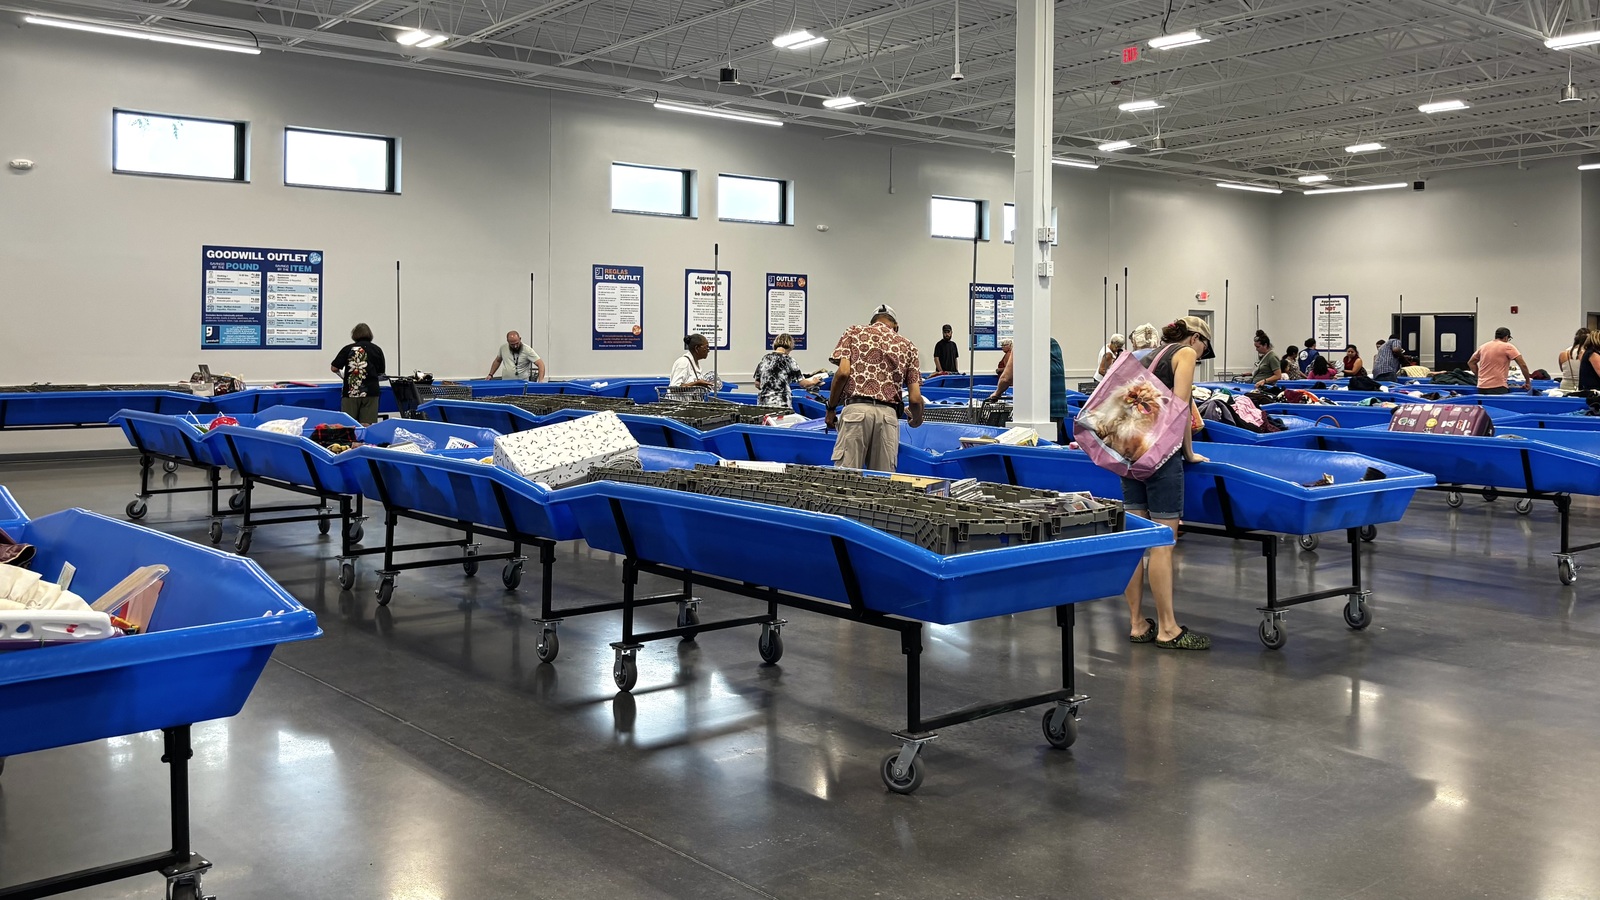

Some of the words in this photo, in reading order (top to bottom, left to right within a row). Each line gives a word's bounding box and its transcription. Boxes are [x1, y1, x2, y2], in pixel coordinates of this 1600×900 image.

[206, 250, 265, 260] GOODWILL
[267, 252, 308, 262] OUTLET
[225, 262, 260, 271] POUND
[290, 264, 312, 272] ITEM
